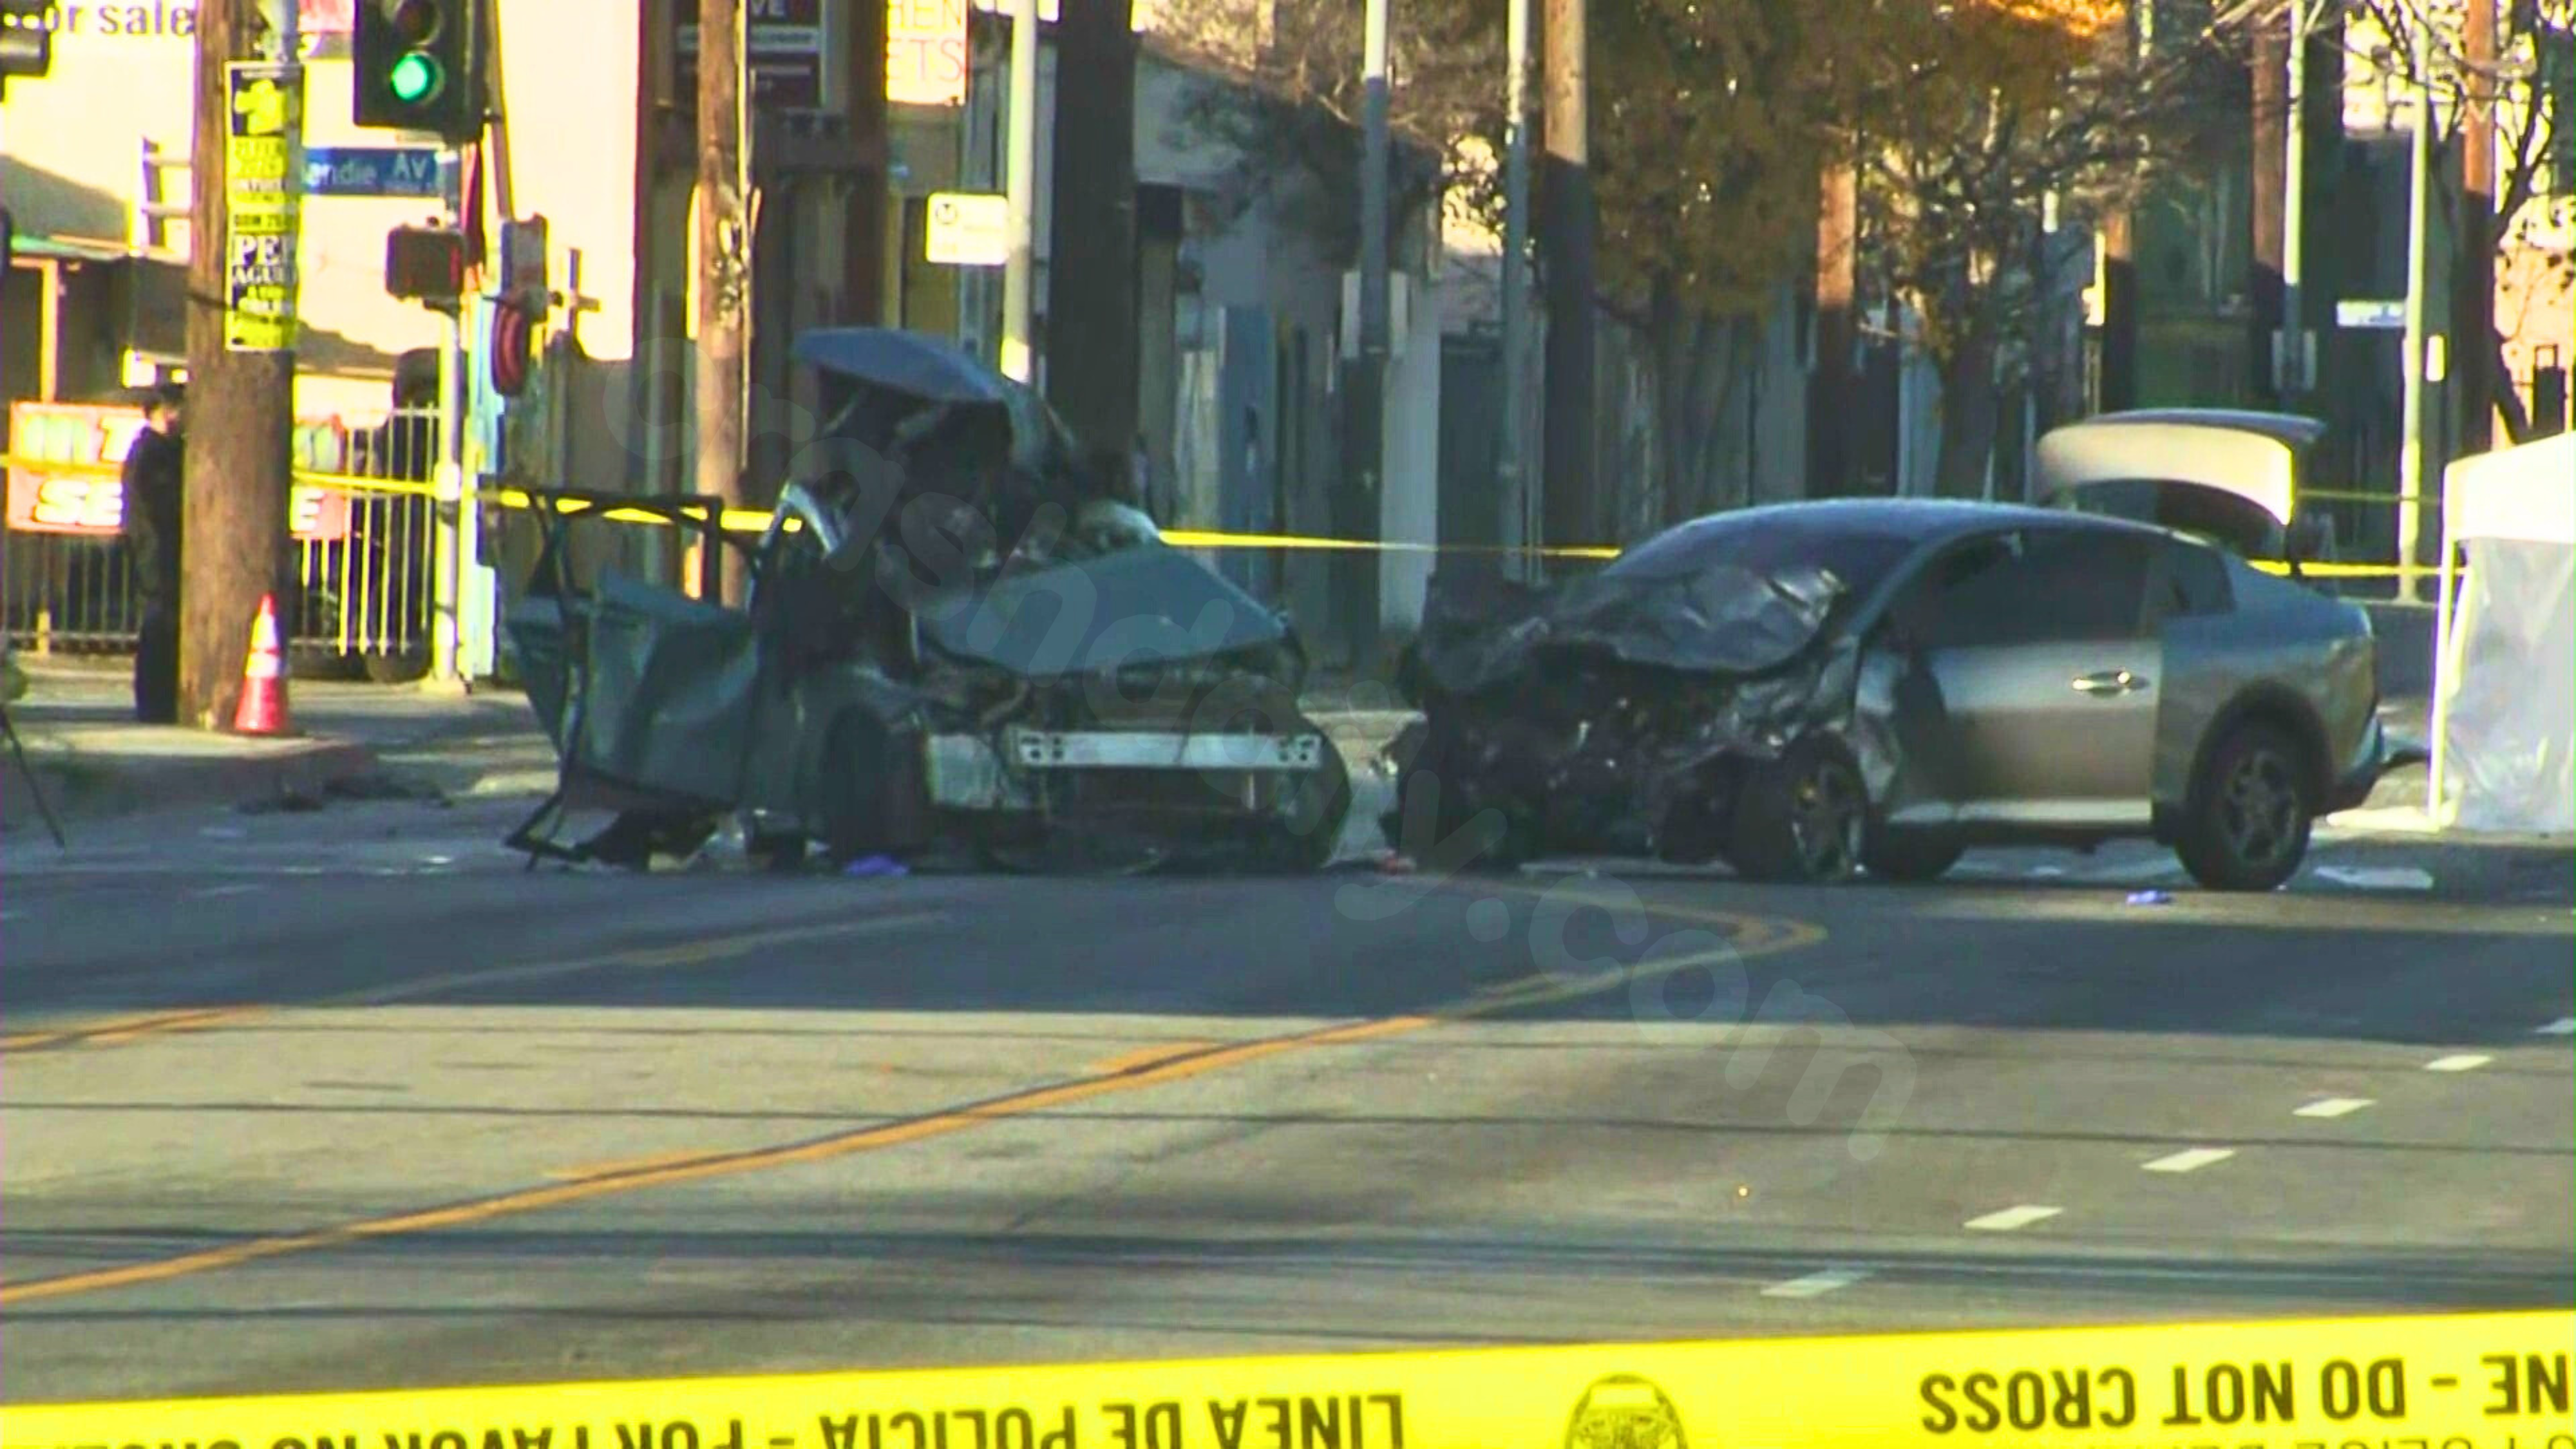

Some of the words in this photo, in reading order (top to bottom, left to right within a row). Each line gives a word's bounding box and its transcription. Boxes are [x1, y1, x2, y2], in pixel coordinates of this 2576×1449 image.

[98, 0, 195, 35] sale
[1918, 1367, 2137, 1436] CROSS
[2161, 1361, 2295, 1426] NOT
[2320, 1357, 2407, 1421] DO
